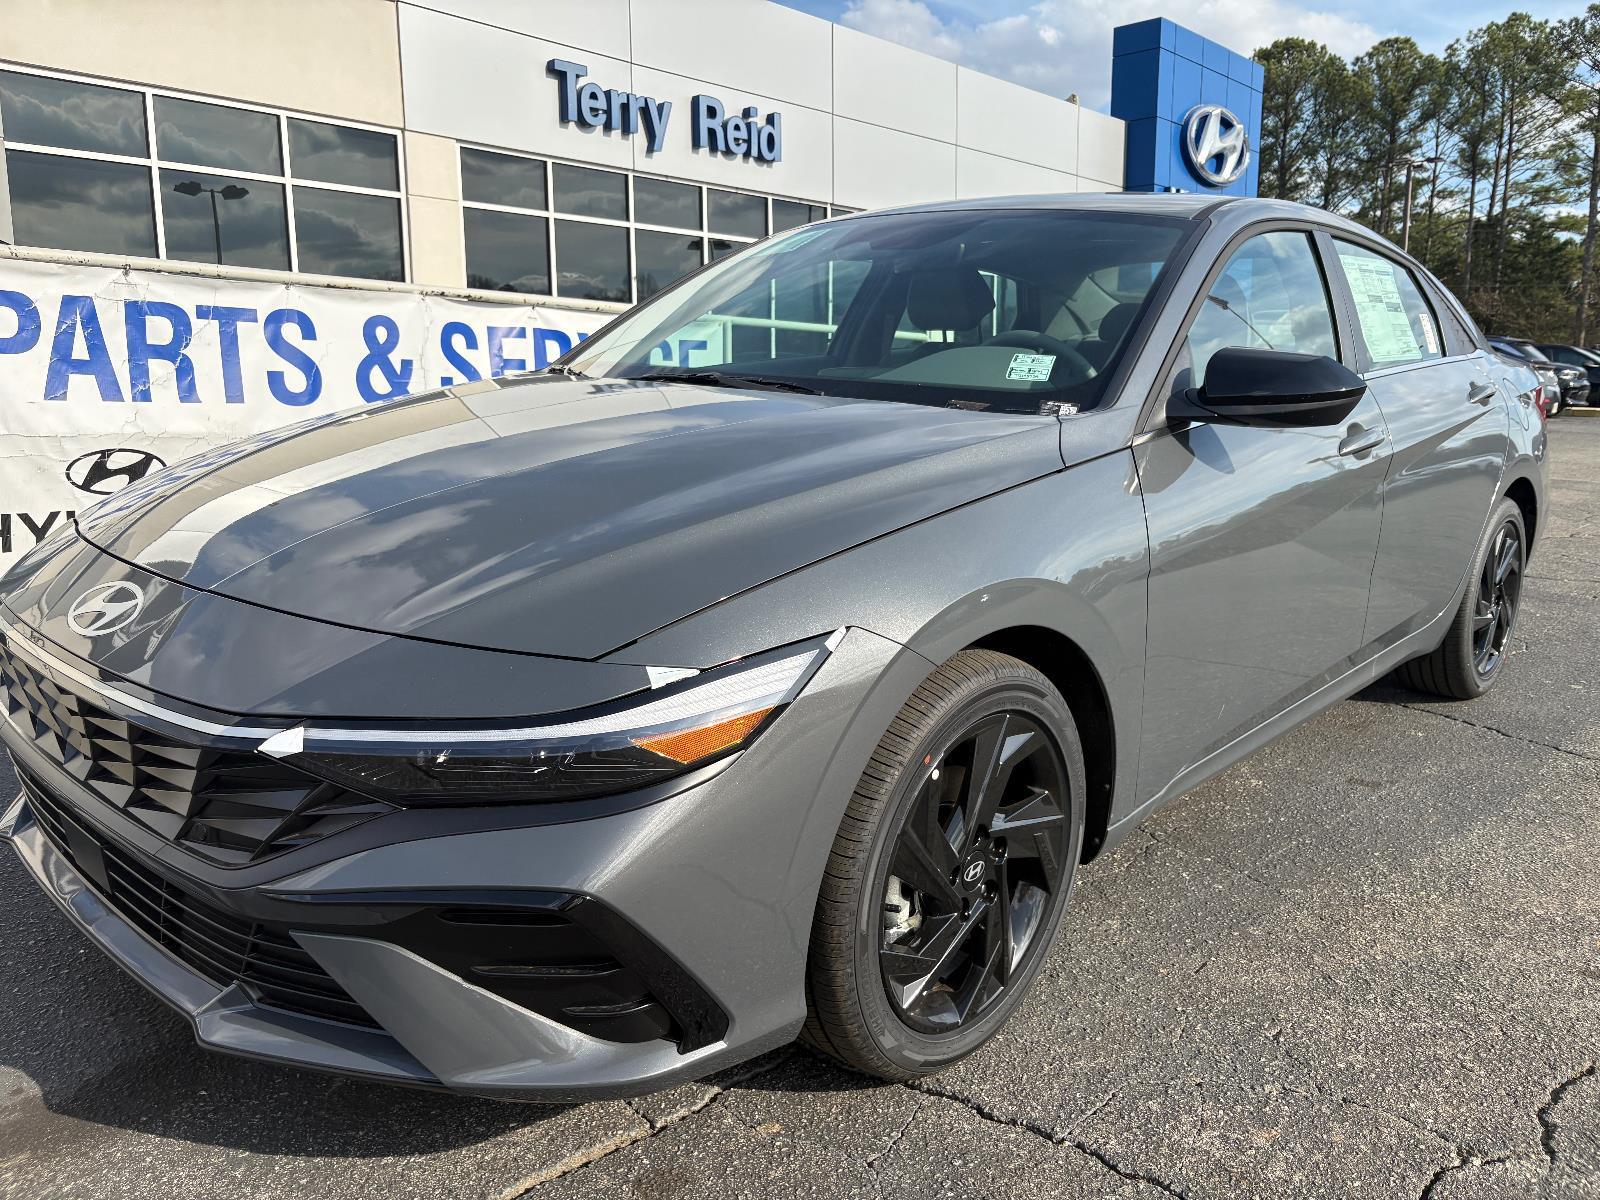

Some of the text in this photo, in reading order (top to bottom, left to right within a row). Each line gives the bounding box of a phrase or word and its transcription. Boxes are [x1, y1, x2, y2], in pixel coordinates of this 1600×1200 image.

[547, 58, 782, 162] Terry Reid
[355, 314, 414, 404] &
